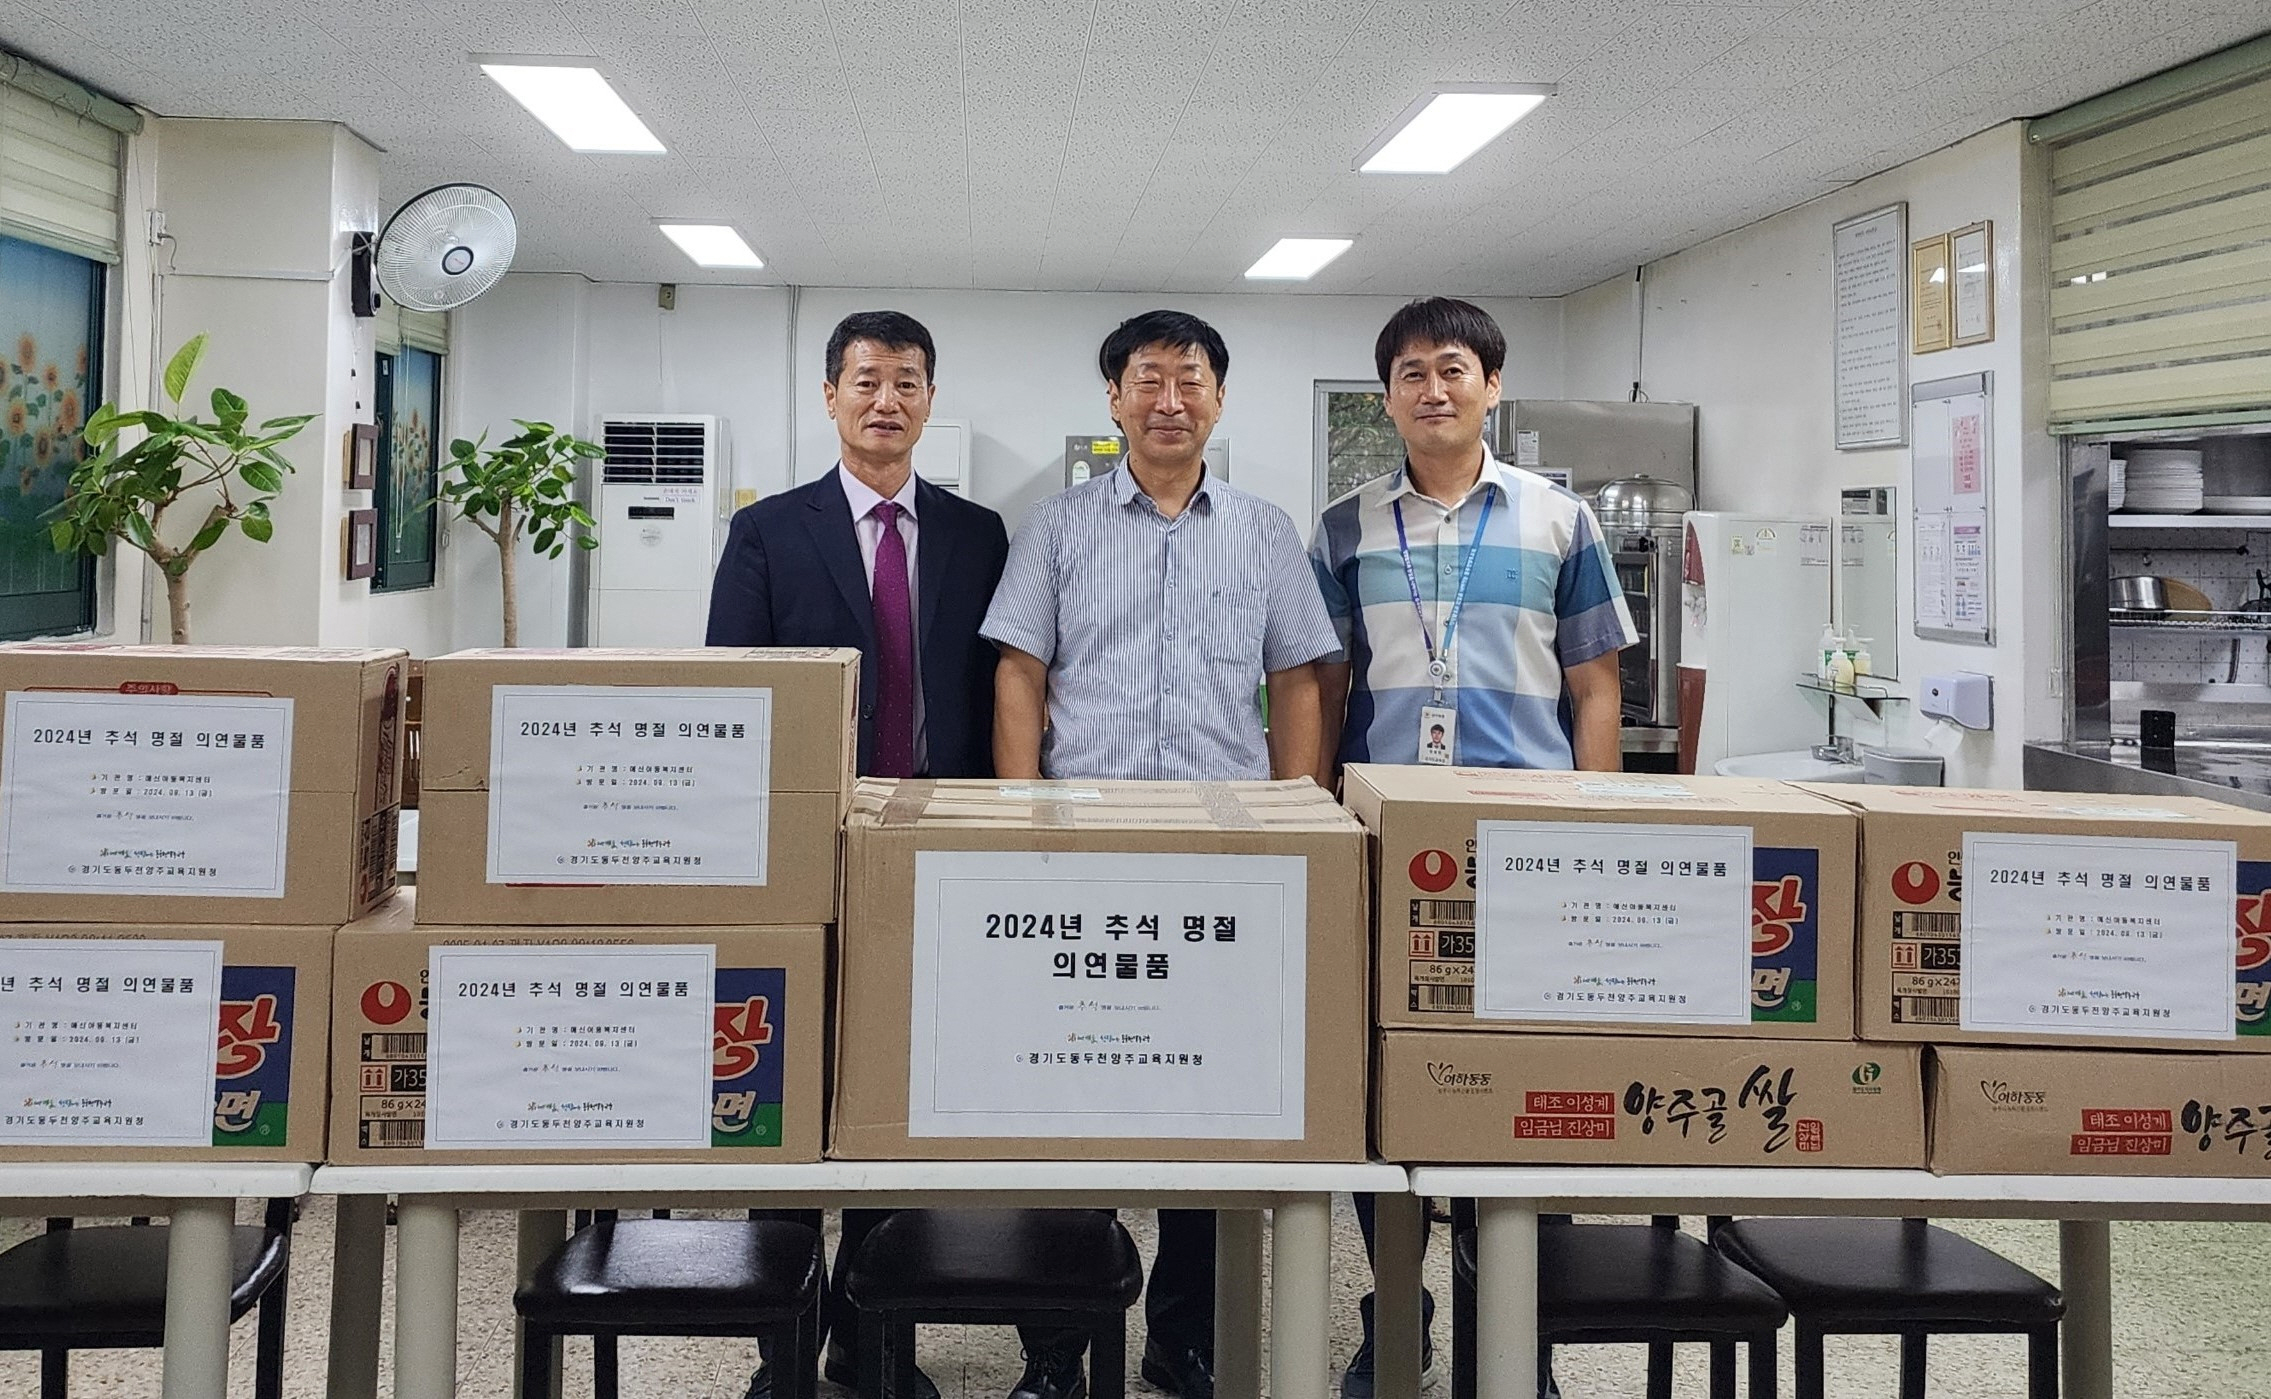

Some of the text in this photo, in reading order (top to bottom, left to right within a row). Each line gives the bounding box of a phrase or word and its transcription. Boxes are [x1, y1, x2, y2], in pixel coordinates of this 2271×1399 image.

[521, 721, 745, 738] 2024년 추석 명절 의연물품
[34, 729, 265, 749] 2024년 추석 명절 의연물품
[570, 856, 701, 865] 경기도동두천양주교육지원청
[1505, 856, 1727, 877] 2024년 추석 명절 의연물품
[81, 863, 216, 878] 경기도동두천양주교육지원청
[1990, 868, 2210, 892] 2024년 추석 명절 의연물품
[986, 914, 1235, 942] 2024년 추석 명절
[1053, 952, 1169, 979] 의연물품
[1430, 965, 1443, 974] 86
[28, 977, 62, 992] 추석
[77, 977, 109, 993] 명절
[122, 976, 196, 993] 의연물품
[457, 981, 688, 997] 2024년 추석 명절 의연물품
[1912, 976, 1925, 986] 86
[1557, 992, 1686, 1004] 경기도동두천양주교육지원청
[2041, 1005, 2170, 1018] 경기도동두천양주교육지원청
[1029, 1051, 1202, 1066] 경기도동두천양주교육지원청
[1533, 1095, 1610, 1114] 태조 이성계
[1624, 1065, 1797, 1153] 양주골 쌀
[5, 1115, 143, 1126] 경기도동두천양주교육지원청
[510, 1119, 644, 1129] 경기도동두천양주교육지원청
[2091, 1112, 2169, 1132] 태조 이성계
[1521, 1119, 1612, 1140] 임금님 진상미
[2077, 1137, 2169, 1156] 임금님 진상미
